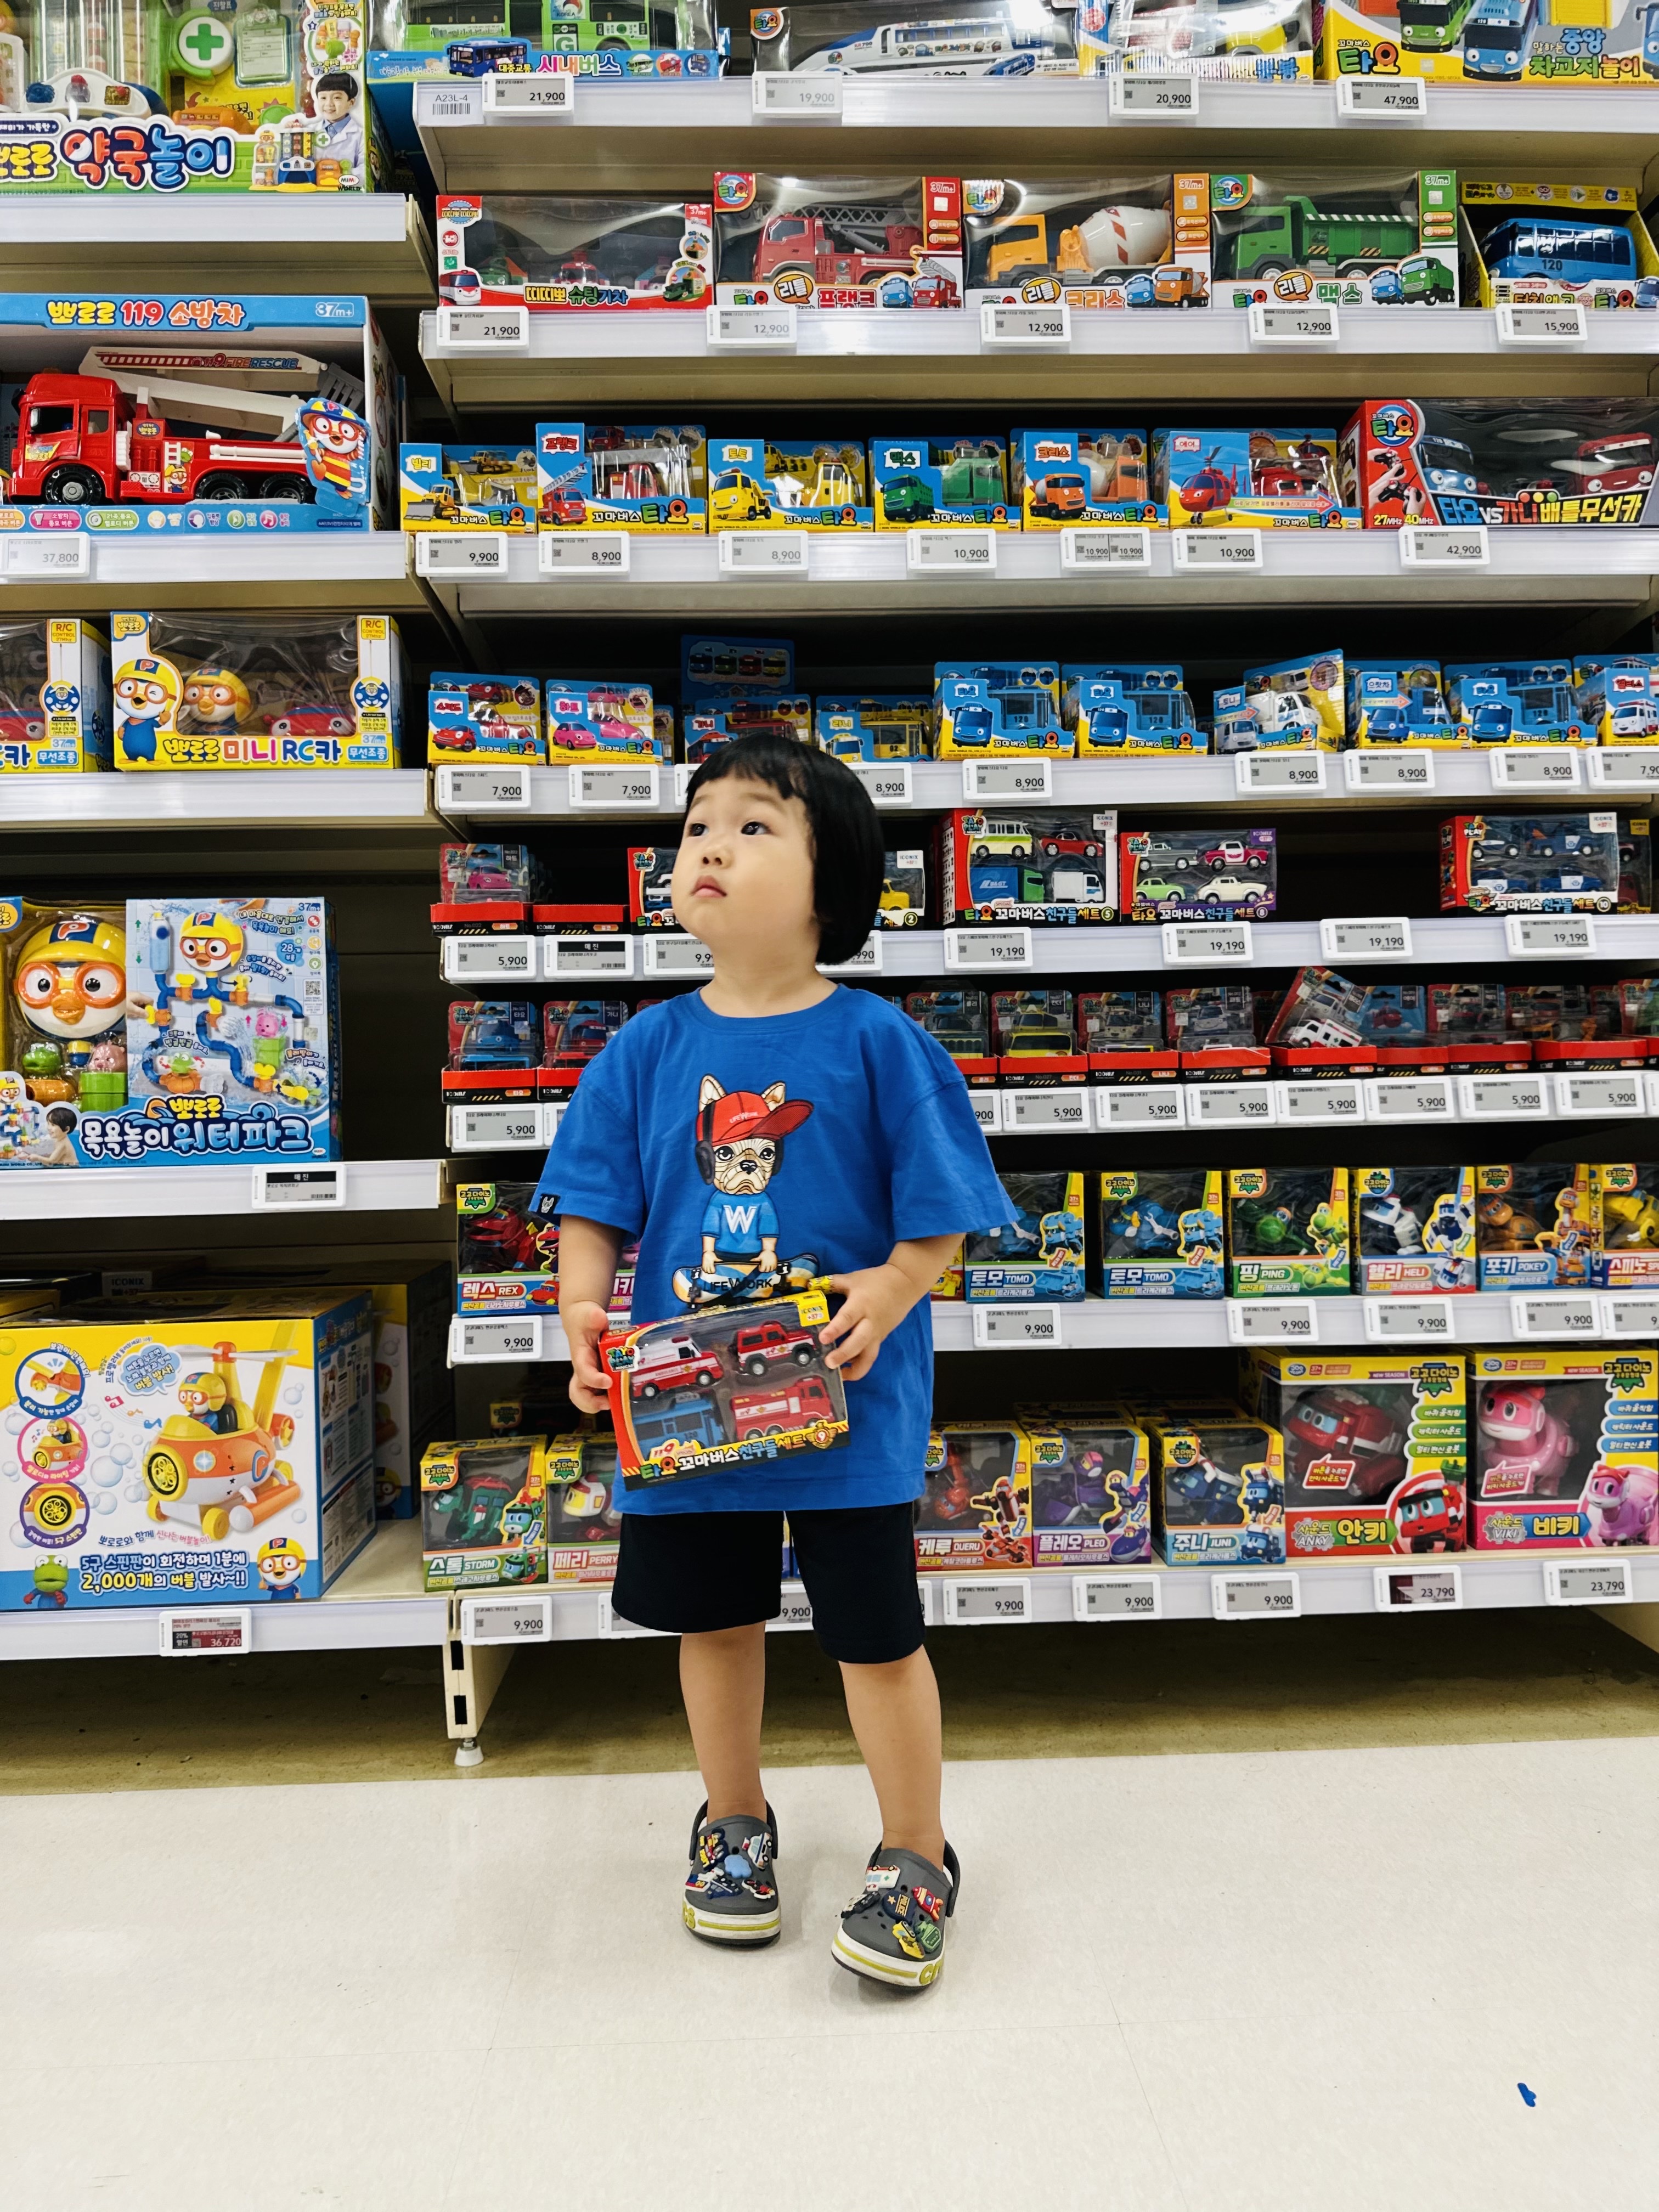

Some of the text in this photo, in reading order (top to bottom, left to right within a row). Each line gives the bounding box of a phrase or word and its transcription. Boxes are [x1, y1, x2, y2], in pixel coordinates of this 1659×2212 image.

[1338, 40, 1370, 48] 꼬마버스
[1533, 28, 1605, 54] 말하는 중앙
[1338, 42, 1400, 75] 타요
[498, 54, 622, 76] 대중교통 시내버스
[529, 92, 565, 104] 21,900
[799, 92, 834, 104] 19,900
[1156, 94, 1191, 105] 20,900
[1384, 95, 1418, 106] 47,900
[63, 124, 229, 187] 약국놀이
[776, 277, 808, 298] 리틀
[526, 285, 629, 306] 띠띠뽀 슈팅기차
[819, 289, 876, 308] 프랭크
[1065, 290, 1125, 308] 크리스
[48, 300, 245, 328] 뽀로로 119 소방차
[484, 326, 520, 336] 21,900
[754, 324, 789, 334] 12,900
[1028, 323, 1063, 332] 12,900
[1296, 322, 1331, 332] 12,900
[1545, 323, 1578, 331] 15,900
[224, 358, 251, 368] FIRE
[251, 358, 299, 369] RESCUE
[545, 437, 577, 450] 프랭크
[728, 448, 747, 459] 토토
[1038, 446, 1070, 458] 크리스
[410, 458, 432, 469] 빌리
[889, 452, 916, 466] 맥스
[450, 507, 525, 526] 꼬마버스 타요
[1374, 515, 1434, 526] 27MHz 40MHz
[954, 549, 989, 559] 10,900
[1220, 549, 1254, 558] 10,900
[1447, 546, 1481, 555] 42,900
[42, 554, 78, 564] 37,800
[469, 552, 498, 563] 9,900
[592, 552, 621, 562] 8,900
[771, 551, 800, 561] 8,900
[56, 623, 72, 632] R/C
[1368, 680, 1390, 689] 으랏차
[1616, 679, 1643, 689] 앨리스
[1222, 697, 1236, 705] 토니
[436, 702, 461, 712] 스피드
[559, 702, 579, 712] 하트
[695, 719, 713, 729] 가니
[833, 719, 851, 728] 라니
[163, 739, 341, 761] 뽀로로 미니 RC카
[40, 752, 76, 763] 무선조종
[1289, 771, 1317, 780] 8,900
[1398, 769, 1426, 778] 8,900
[1544, 767, 1571, 776] 8,900
[1015, 778, 1044, 787] 8,900
[493, 787, 521, 797] 7,900
[622, 786, 651, 795] 7,900
[876, 783, 905, 793] 8,900
[963, 823, 983, 831] PLAY
[964, 906, 992, 921] 타요
[995, 908, 1045, 920] 꼬마버스
[1046, 907, 1077, 923] 친구들
[1077, 907, 1101, 919] 세트
[1369, 938, 1403, 947] 19,190
[1554, 933, 1587, 943] 19,190
[1211, 942, 1244, 951] 19,190
[990, 948, 1024, 957] 19,190
[498, 956, 527, 966] 5,900
[1418, 1098, 1445, 1108] 5,900
[1512, 1096, 1539, 1105] 5,900
[1609, 1093, 1635, 1103] 5,900
[171, 1098, 222, 1118] 뽀로로
[1149, 1105, 1176, 1115] 5,900
[1239, 1103, 1268, 1112] 5,900
[1328, 1101, 1356, 1110] 5,900
[1054, 1108, 1081, 1118] 5,900
[82, 1116, 312, 1153] 목욕놀이 워터파크
[506, 1125, 535, 1135] 5,900
[724, 1205, 757, 1233] W
[1486, 1259, 1516, 1274] 포키
[1110, 1268, 1169, 1284] 토모 TOMO
[1240, 1265, 1285, 1282] 핑 PING
[1369, 1264, 1424, 1280] 헬리 HELI
[971, 1271, 1030, 1285] 토모 TOMO
[703, 1277, 774, 1291] LIFEWORK
[462, 1282, 518, 1299] 렉스 REX
[1282, 1321, 1310, 1330] 9,900
[1418, 1319, 1446, 1328] 9,900
[1565, 1316, 1592, 1325] 9,900
[1025, 1324, 1053, 1335] 9,900
[504, 1338, 533, 1347] 9,900
[640, 1458, 676, 1479] 타요
[679, 1448, 740, 1470] 꼬마버스
[740, 1440, 778, 1458] 친구들
[776, 1435, 806, 1448] 세트
[1489, 1516, 1579, 1535] 사운드 비키
[1297, 1520, 1387, 1544] 사운드 안키
[1494, 1529, 1517, 1539] VIKI
[99, 1536, 134, 1546] 뽀로로와
[135, 1530, 154, 1541] 함께
[1040, 1535, 1105, 1551] 플레오 PLEO
[1175, 1534, 1231, 1550] 주니 JUNI
[1297, 1536, 1330, 1546] ANKY
[919, 1539, 951, 1554] 케루
[82, 1552, 247, 1572] 5구 스핀판이 회전하며 1분에
[430, 1556, 495, 1575] 스톰 STORM
[554, 1551, 618, 1570] 페리 PERRY
[82, 1572, 166, 1590] 2,000개의
[171, 1573, 195, 1589] 버블
[1591, 1582, 1624, 1591] 23,790
[1421, 1588, 1454, 1598] 23,790
[1125, 1598, 1153, 1607] 9,900
[1265, 1596, 1293, 1605] 9,900
[995, 1601, 1023, 1611] 9,900
[782, 1607, 811, 1618] 9,900
[514, 1620, 543, 1629] 9,900
[211, 1638, 241, 1647] 36,720
[896, 1893, 908, 1917] POLICE
